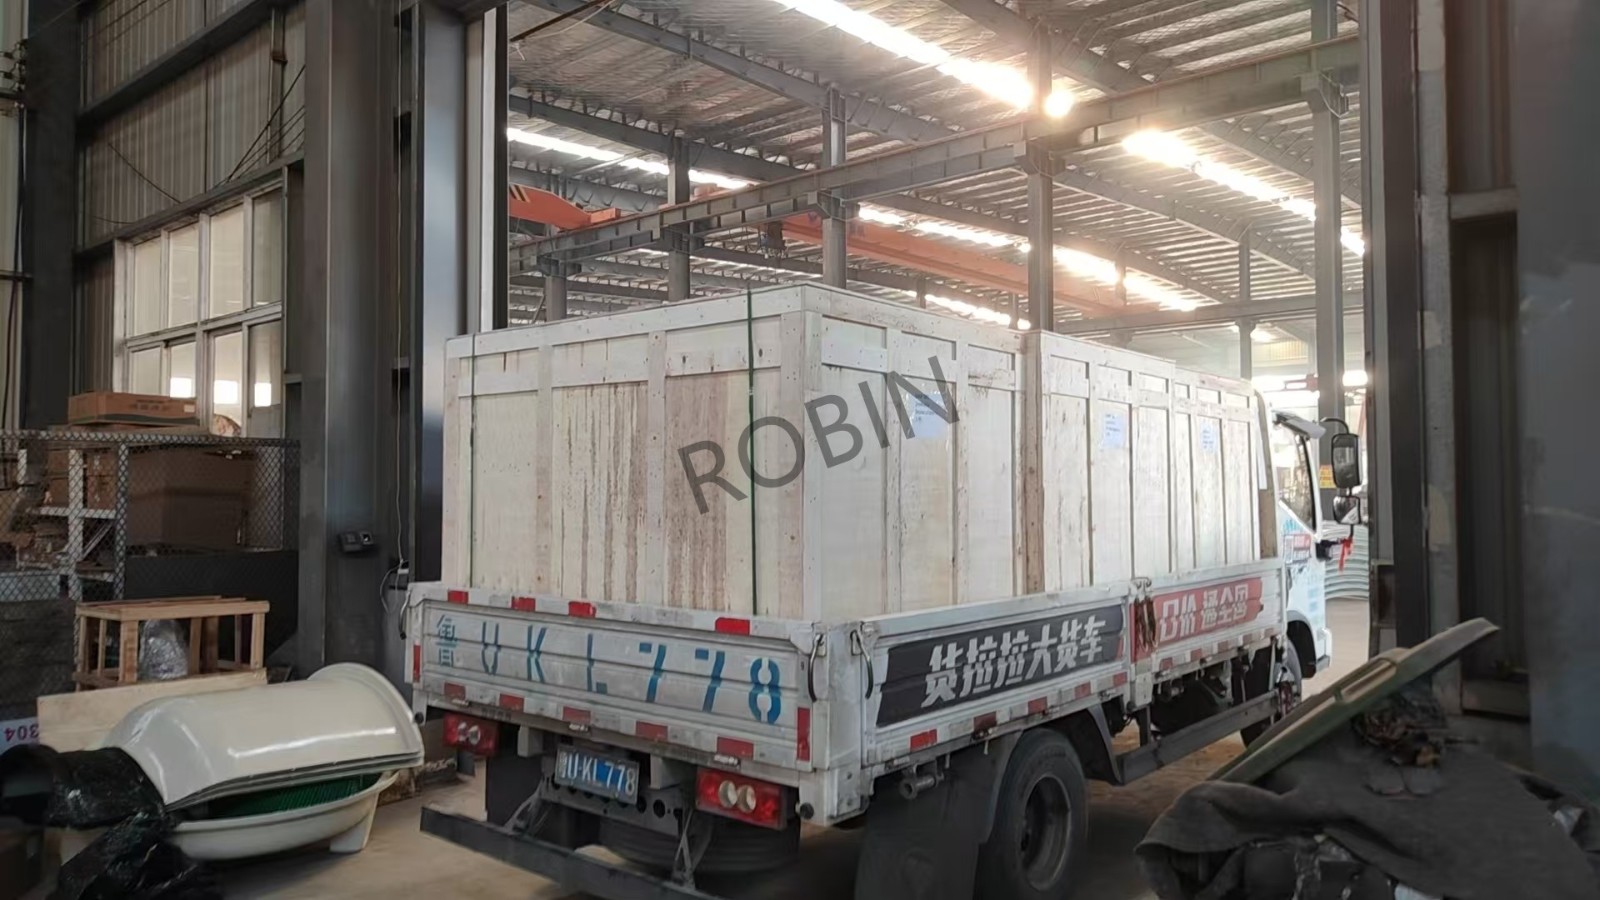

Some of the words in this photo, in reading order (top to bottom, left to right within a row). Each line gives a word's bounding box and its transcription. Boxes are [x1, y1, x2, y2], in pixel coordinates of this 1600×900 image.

[920, 615, 1106, 708] 货拉拉大货车
